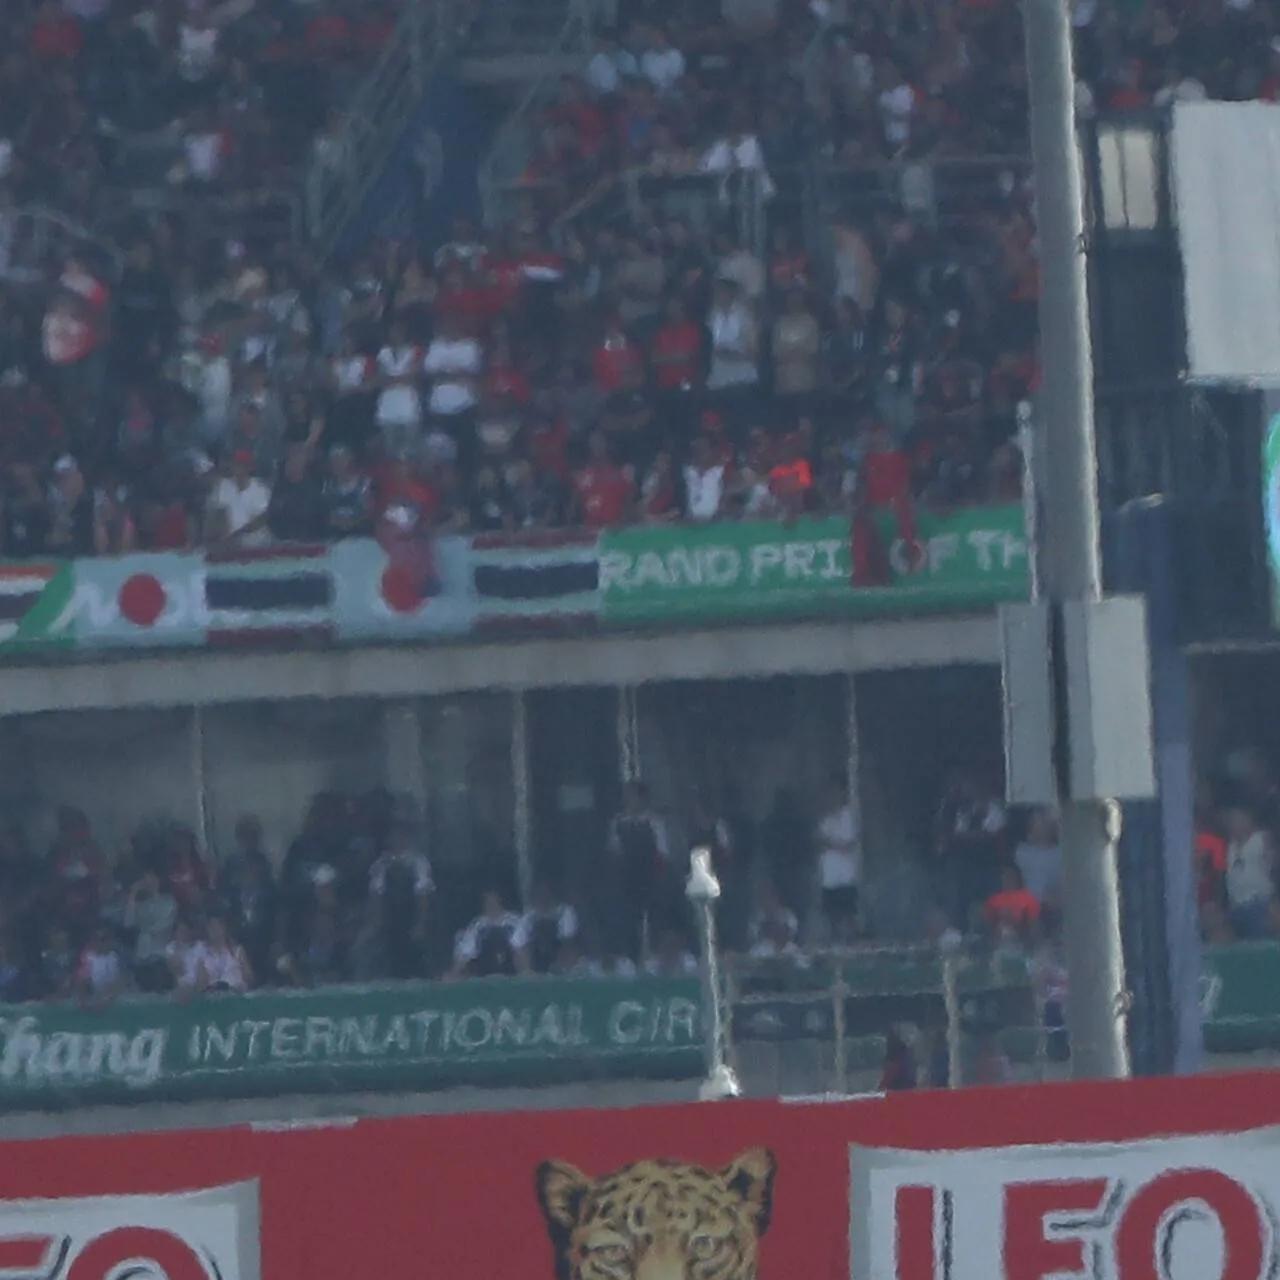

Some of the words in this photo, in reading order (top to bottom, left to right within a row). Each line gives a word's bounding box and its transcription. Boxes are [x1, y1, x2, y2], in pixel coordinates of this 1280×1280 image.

[598, 538, 741, 591] RAND
[748, 536, 852, 586] PRI
[188, 1003, 588, 1063] INTERNATIONAL
